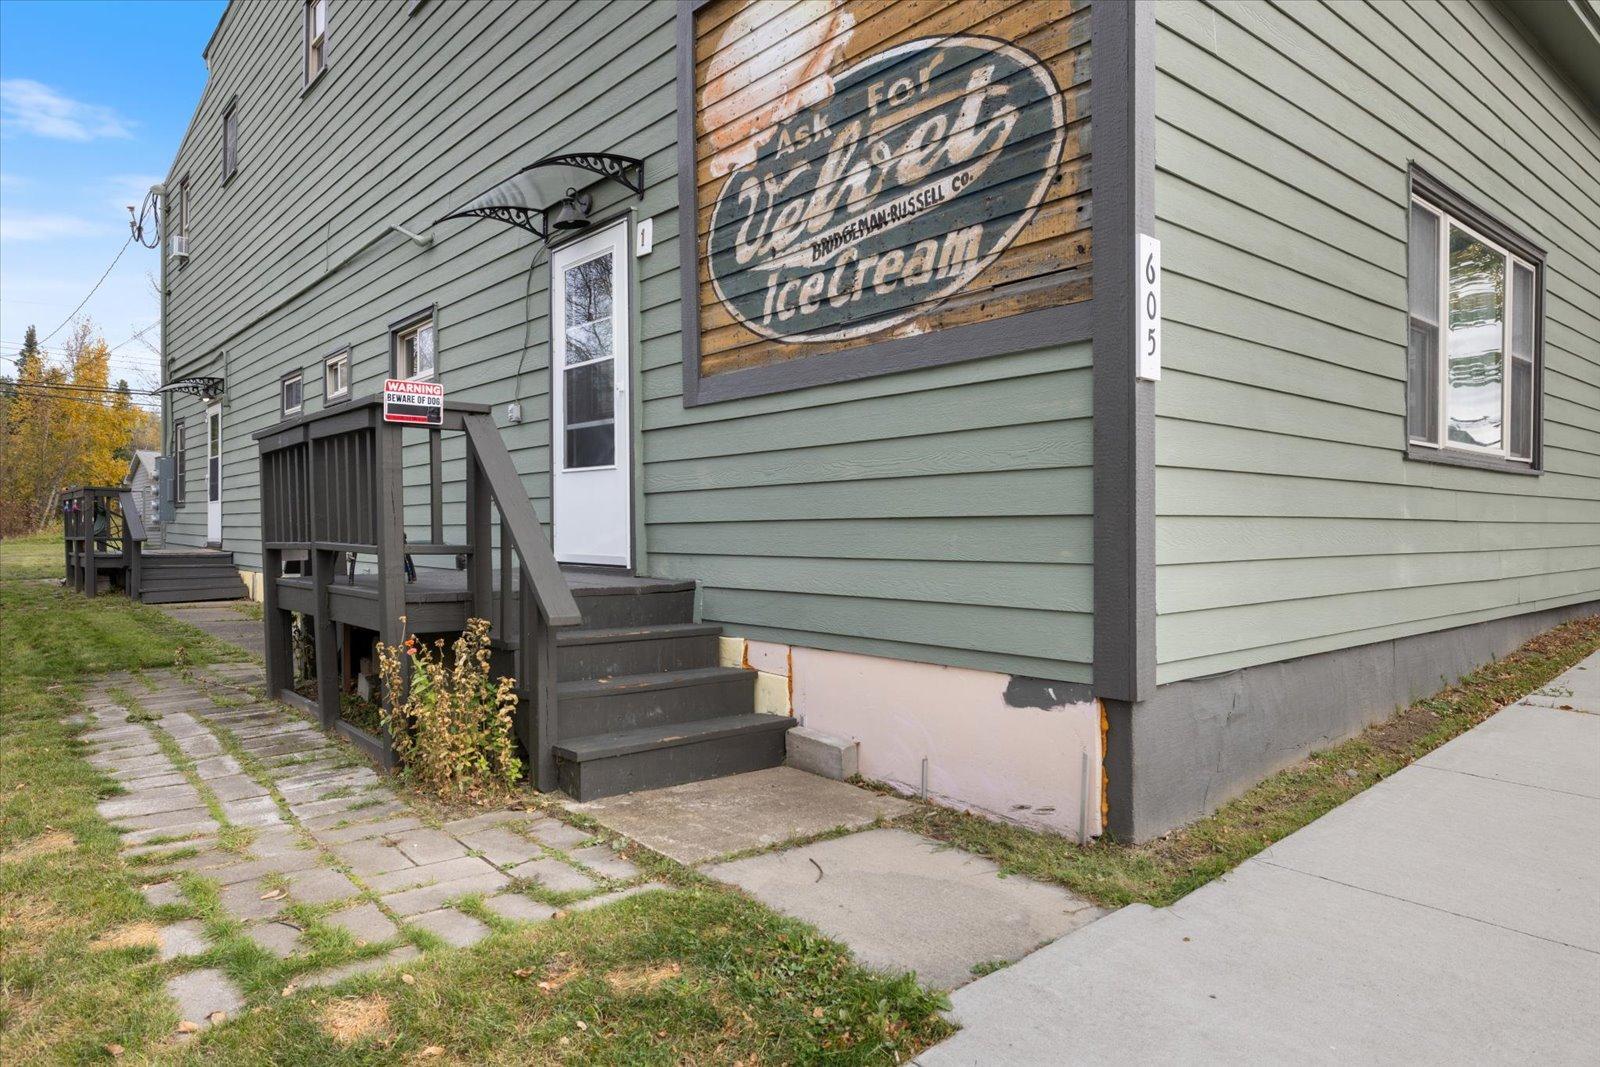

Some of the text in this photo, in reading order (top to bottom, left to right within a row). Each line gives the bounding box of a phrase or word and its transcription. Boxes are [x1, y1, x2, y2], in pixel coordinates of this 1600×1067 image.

[735, 64, 1020, 264] Velvet
[640, 228, 646, 247] 1
[811, 172, 974, 262] BRIDGEMAN-RUSSELL CO.
[1145, 252, 1157, 357] 605
[387, 381, 441, 395] WARNING
[387, 393, 441, 406] BEWARE OF DOG
